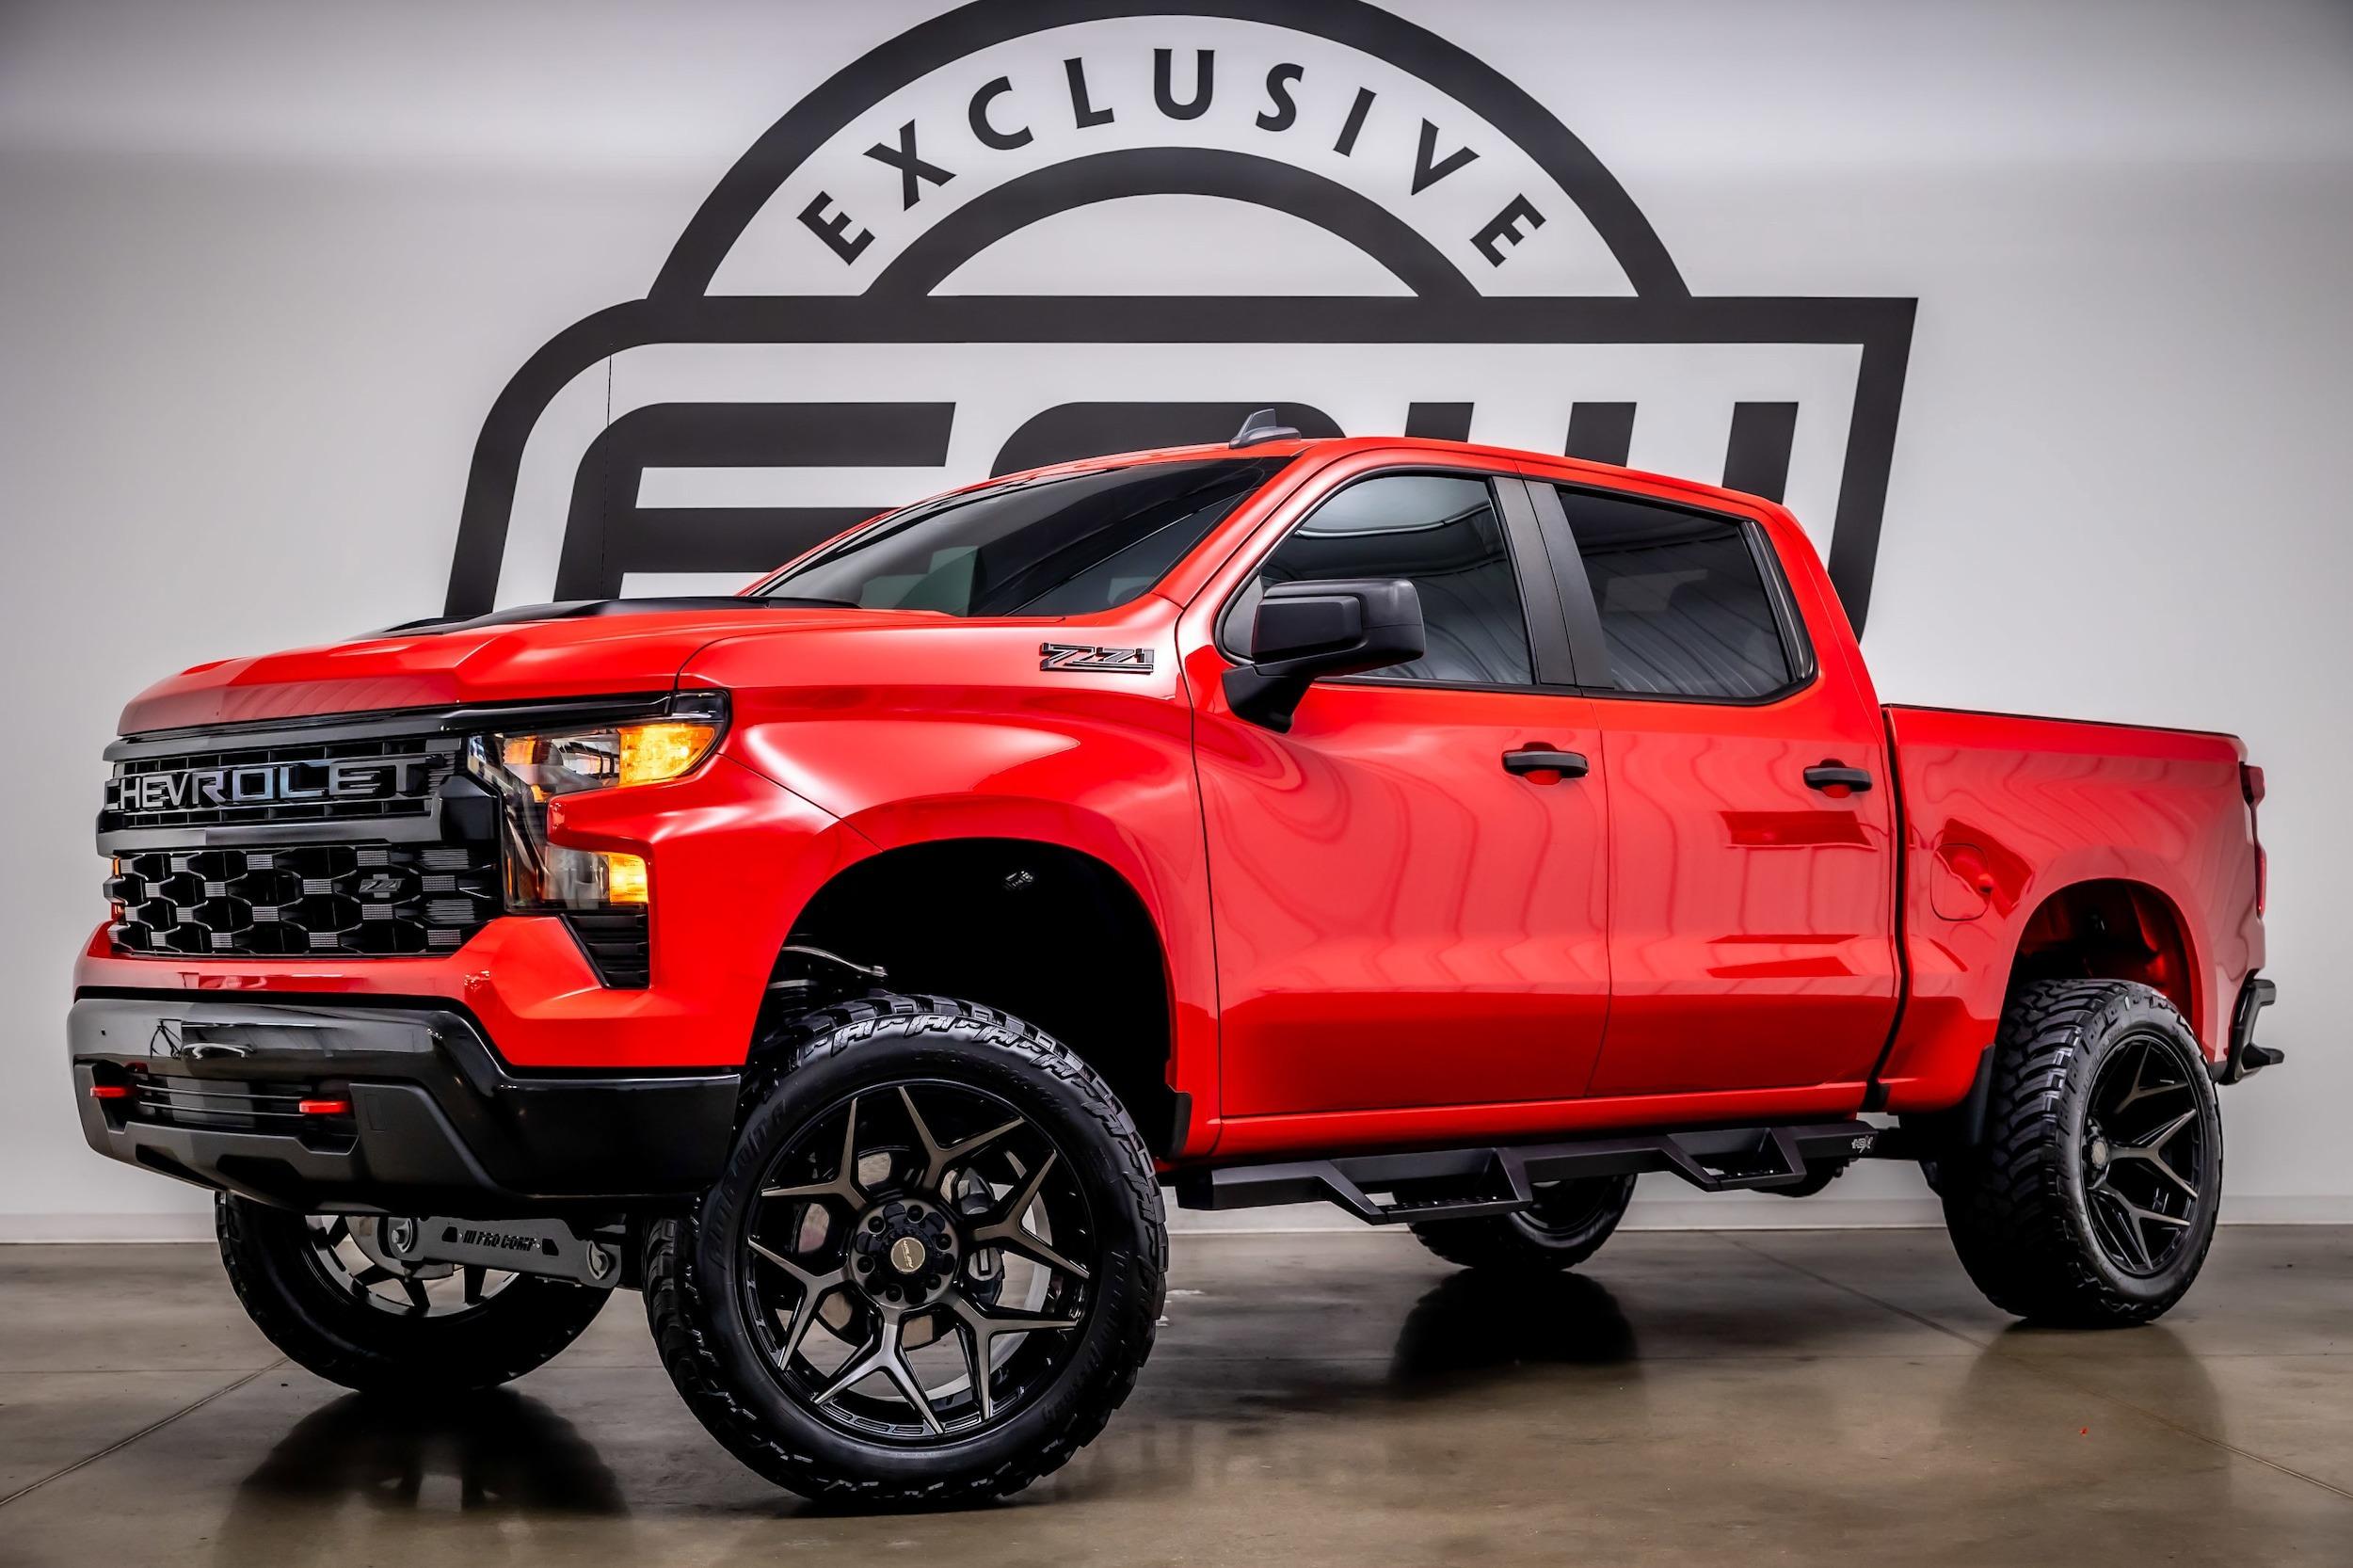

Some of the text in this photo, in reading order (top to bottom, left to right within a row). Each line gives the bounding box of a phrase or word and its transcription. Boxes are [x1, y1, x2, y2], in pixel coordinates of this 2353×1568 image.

[796, 47, 1547, 268] EXCLUSIVE
[1040, 642, 1155, 674] Z71
[102, 755, 427, 812] CHEVROLET
[475, 1230, 536, 1252] PRO COMP
